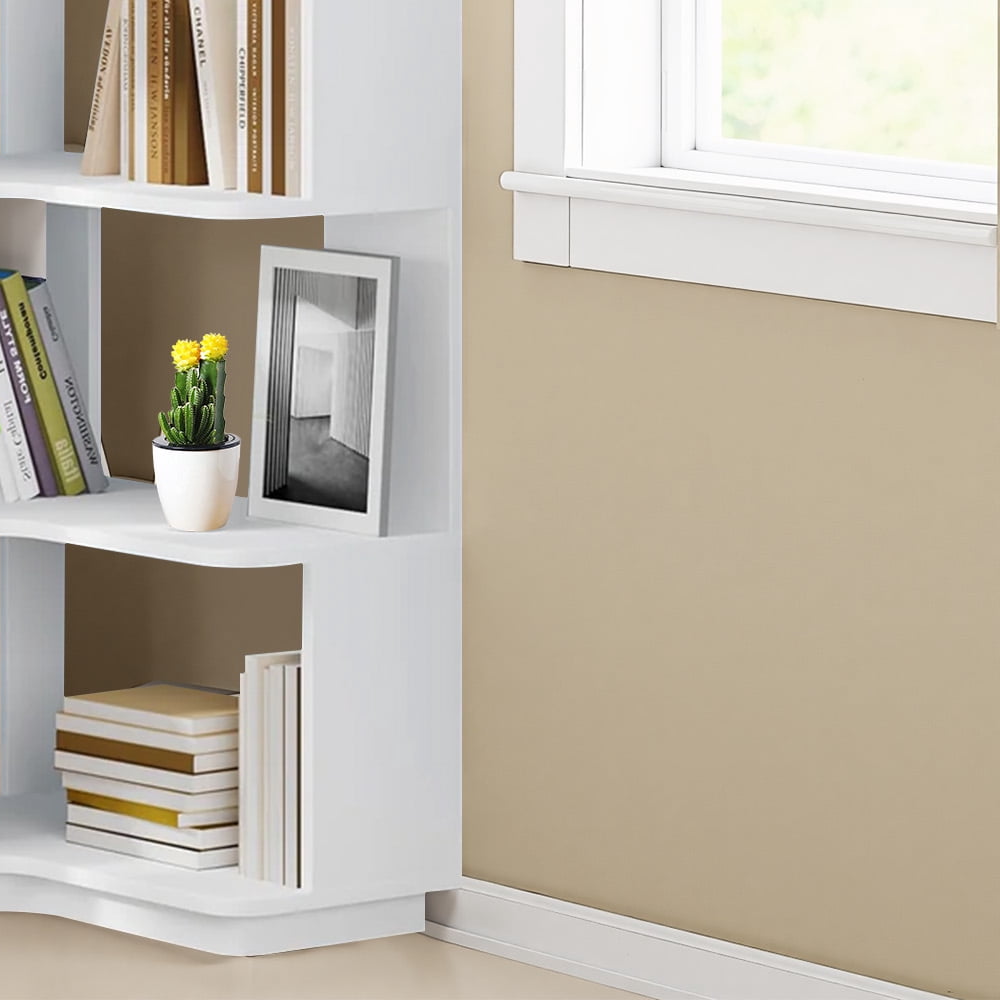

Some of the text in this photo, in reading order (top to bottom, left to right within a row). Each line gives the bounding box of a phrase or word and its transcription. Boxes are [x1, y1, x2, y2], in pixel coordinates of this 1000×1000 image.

[150, 1, 158, 65] KONSTEN
[193, 6, 207, 68] CHANEL
[88, 25, 113, 132] AVEDON advertising
[238, 47, 247, 130] CHIPPERFIELD
